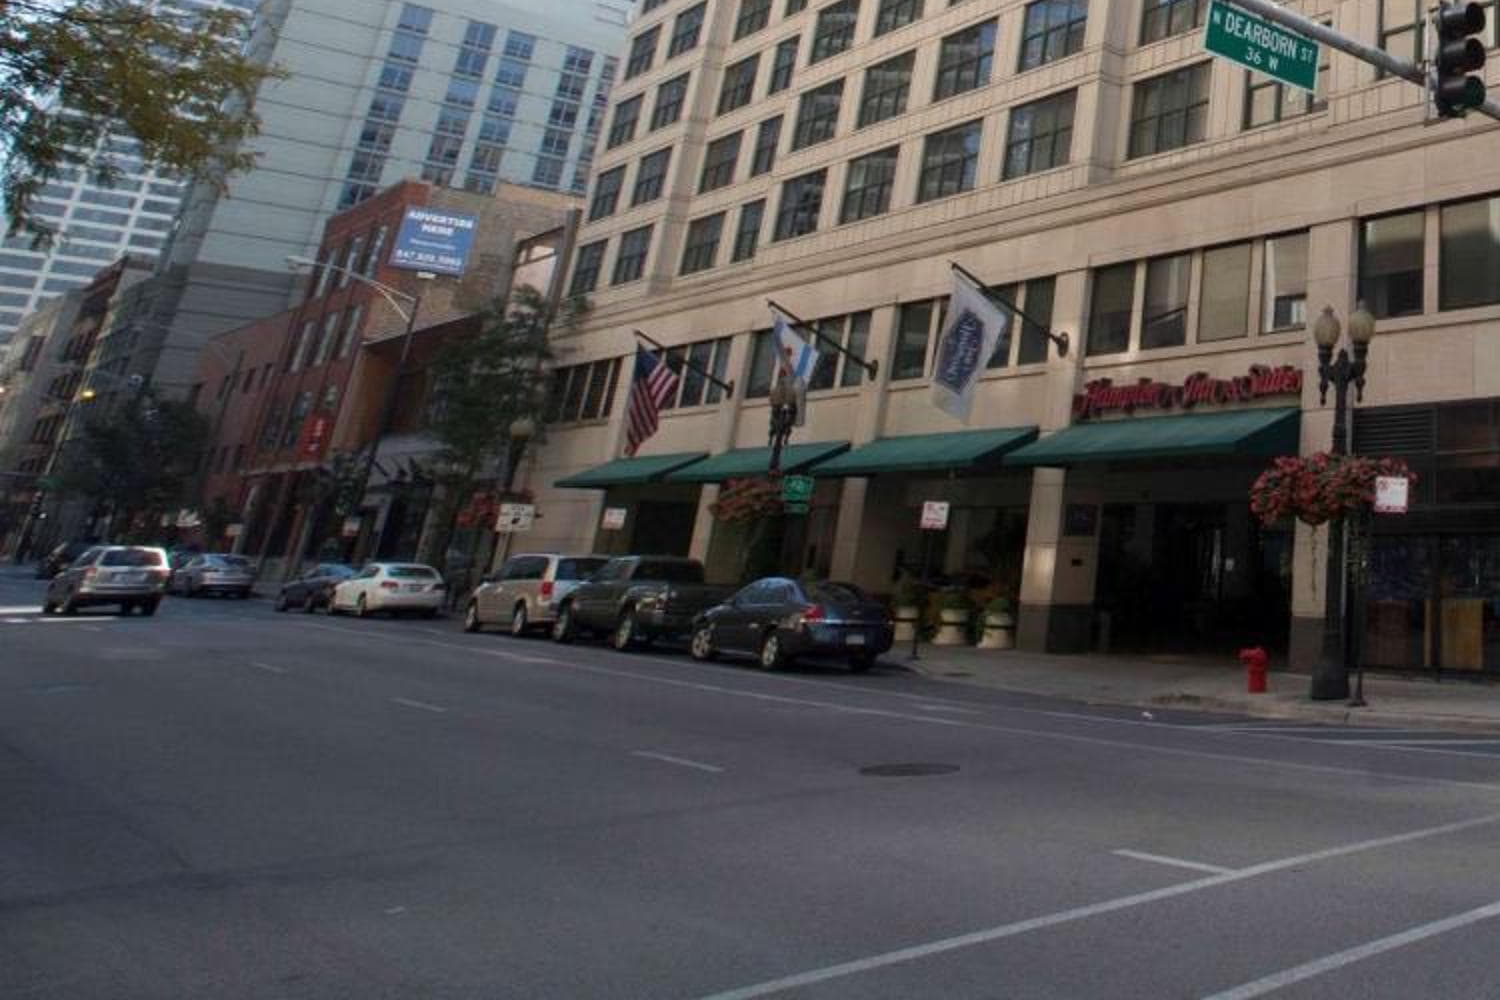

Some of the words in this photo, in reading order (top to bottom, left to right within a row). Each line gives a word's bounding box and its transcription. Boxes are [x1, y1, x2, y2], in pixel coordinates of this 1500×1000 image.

[1224, 12, 1298, 59] DEARBORN
[1301, 46, 1313, 64] ST
[1245, 46, 1262, 65] 36
[1268, 55, 1279, 71] W
